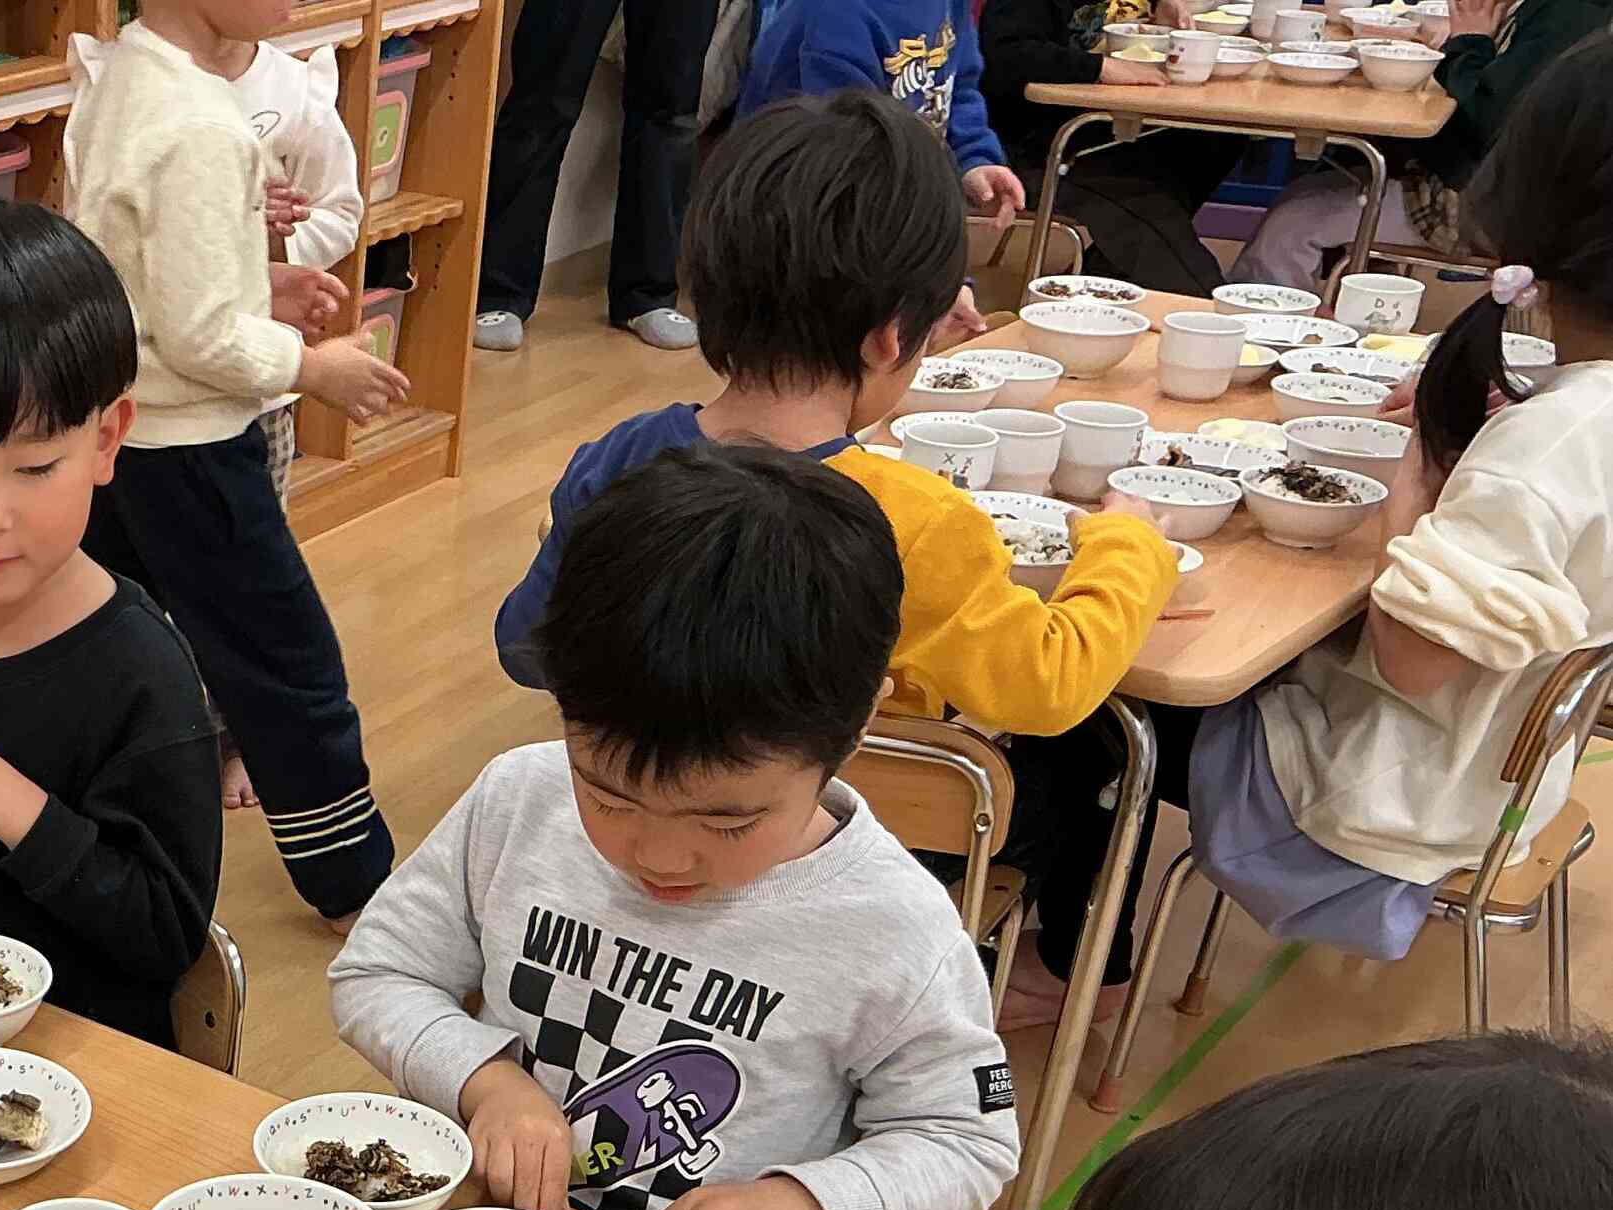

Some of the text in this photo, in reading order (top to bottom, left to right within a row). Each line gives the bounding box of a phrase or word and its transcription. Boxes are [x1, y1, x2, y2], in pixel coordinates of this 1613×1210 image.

[523, 906, 784, 1042] WIN THE DAY
